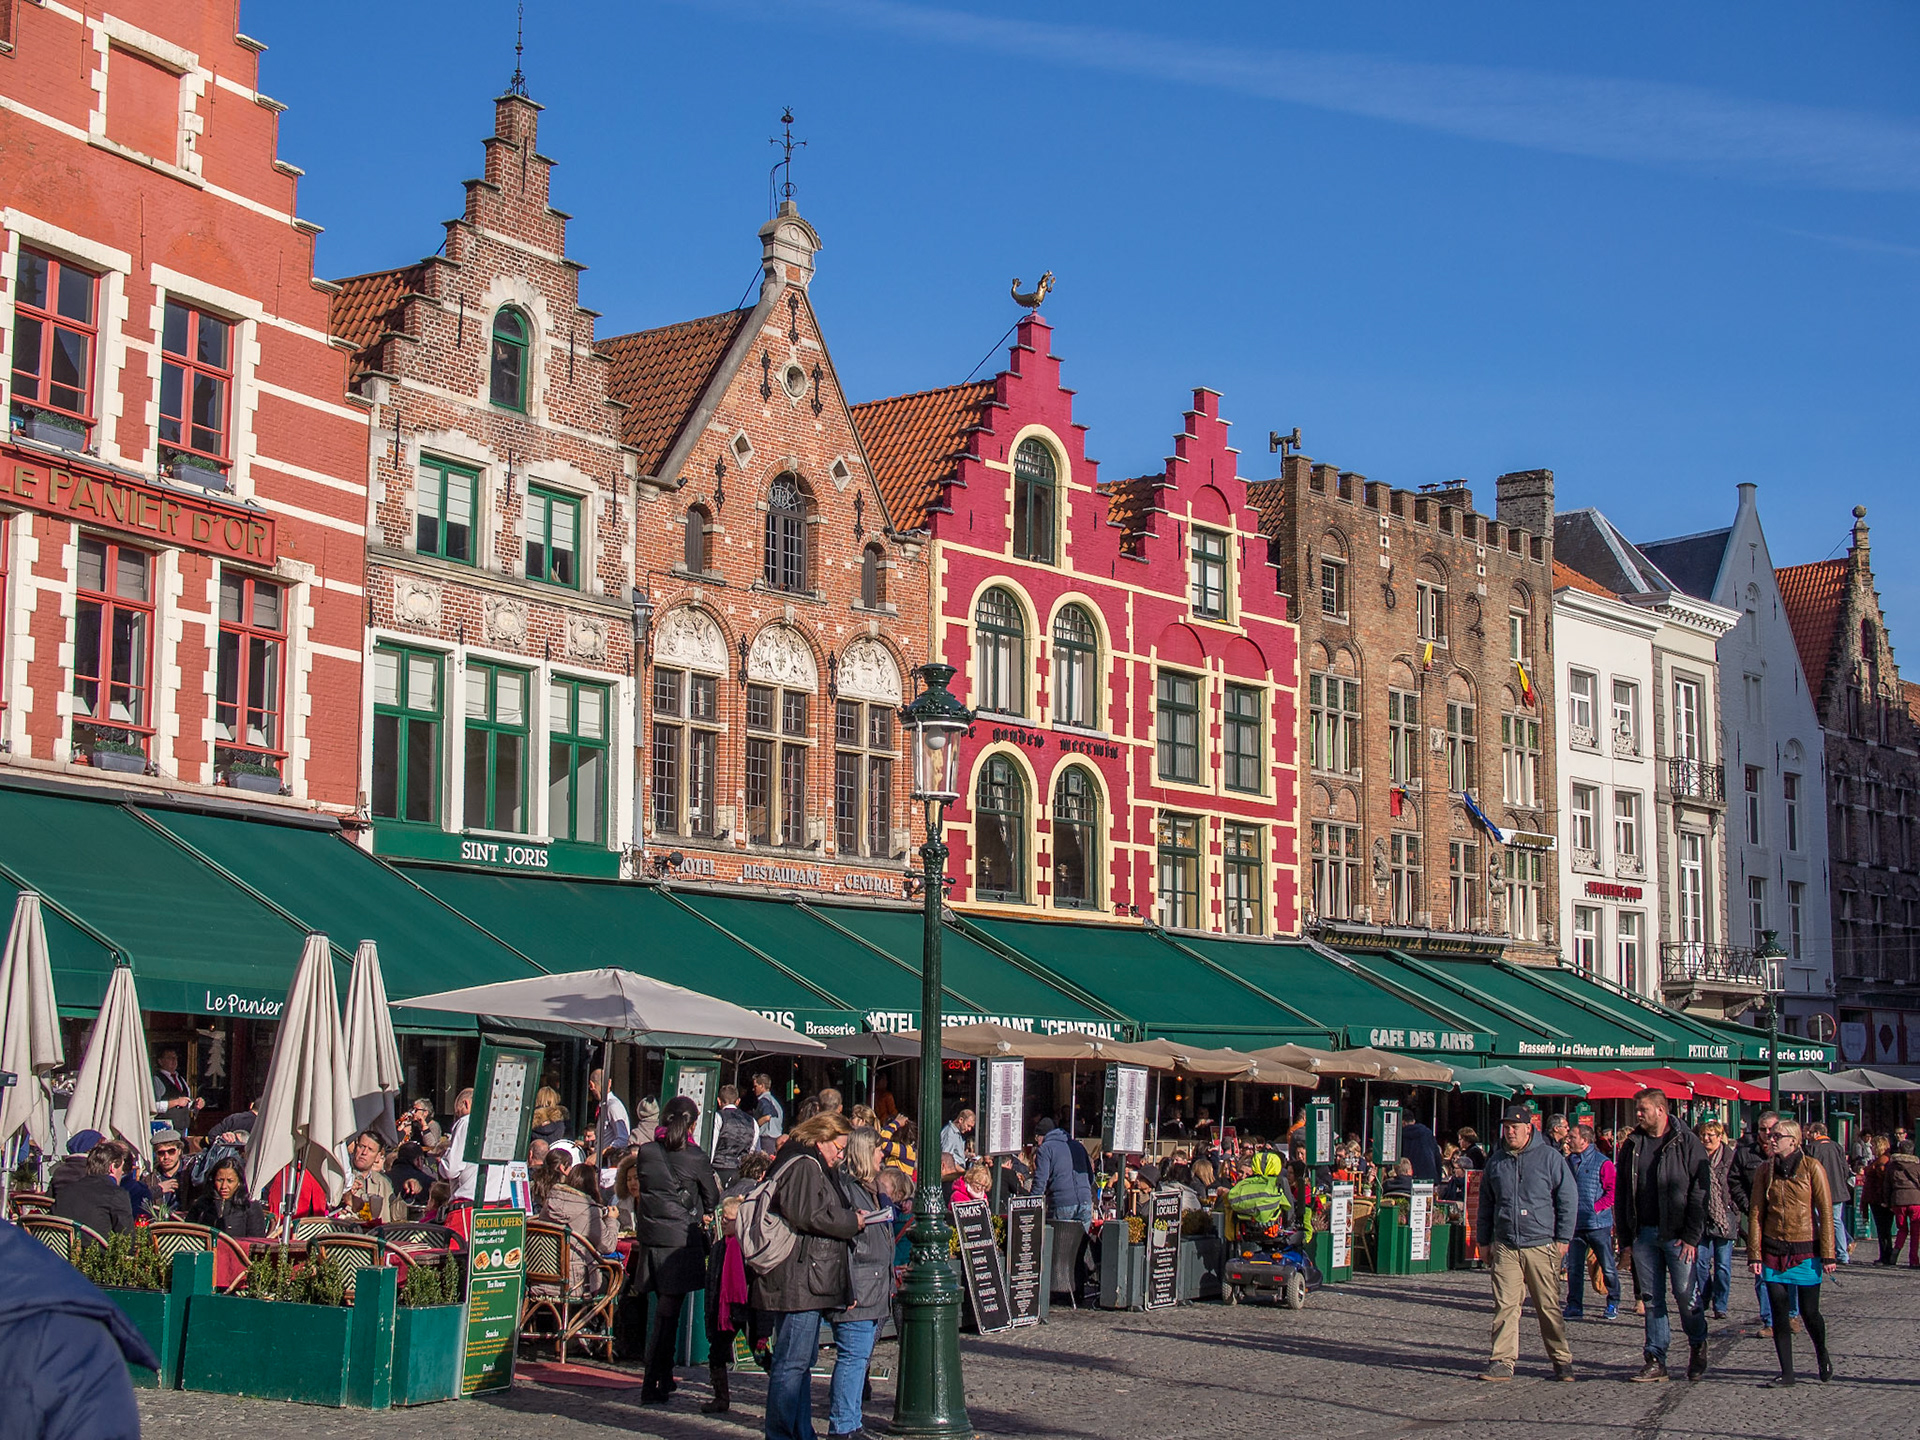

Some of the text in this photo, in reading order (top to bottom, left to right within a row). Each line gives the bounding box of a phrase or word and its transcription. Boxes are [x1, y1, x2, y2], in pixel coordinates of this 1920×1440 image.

[48, 467, 182, 536] PANIER
[192, 513, 268, 558] D'OR
[1060, 739, 1118, 760] meermin
[461, 842, 548, 868] SINT JORIS
[743, 864, 822, 886] RESTAURANT
[845, 874, 896, 893] CENTRAL
[206, 990, 284, 1016] Le Panier
[805, 1021, 856, 1036] Brasserie
[1370, 1028, 1475, 1050] CAFE DES ARTS
[1519, 1042, 1655, 1057] Brasserie La Civiere d'Or Restaurant
[1688, 1044, 1729, 1058] PETIT CAFE
[1759, 1047, 1824, 1061] Frerie 1900
[958, 1205, 982, 1218] SNACKS
[1156, 1206, 1178, 1215] LOCALES
[475, 1217, 523, 1228] SPECIAL OFFERS
